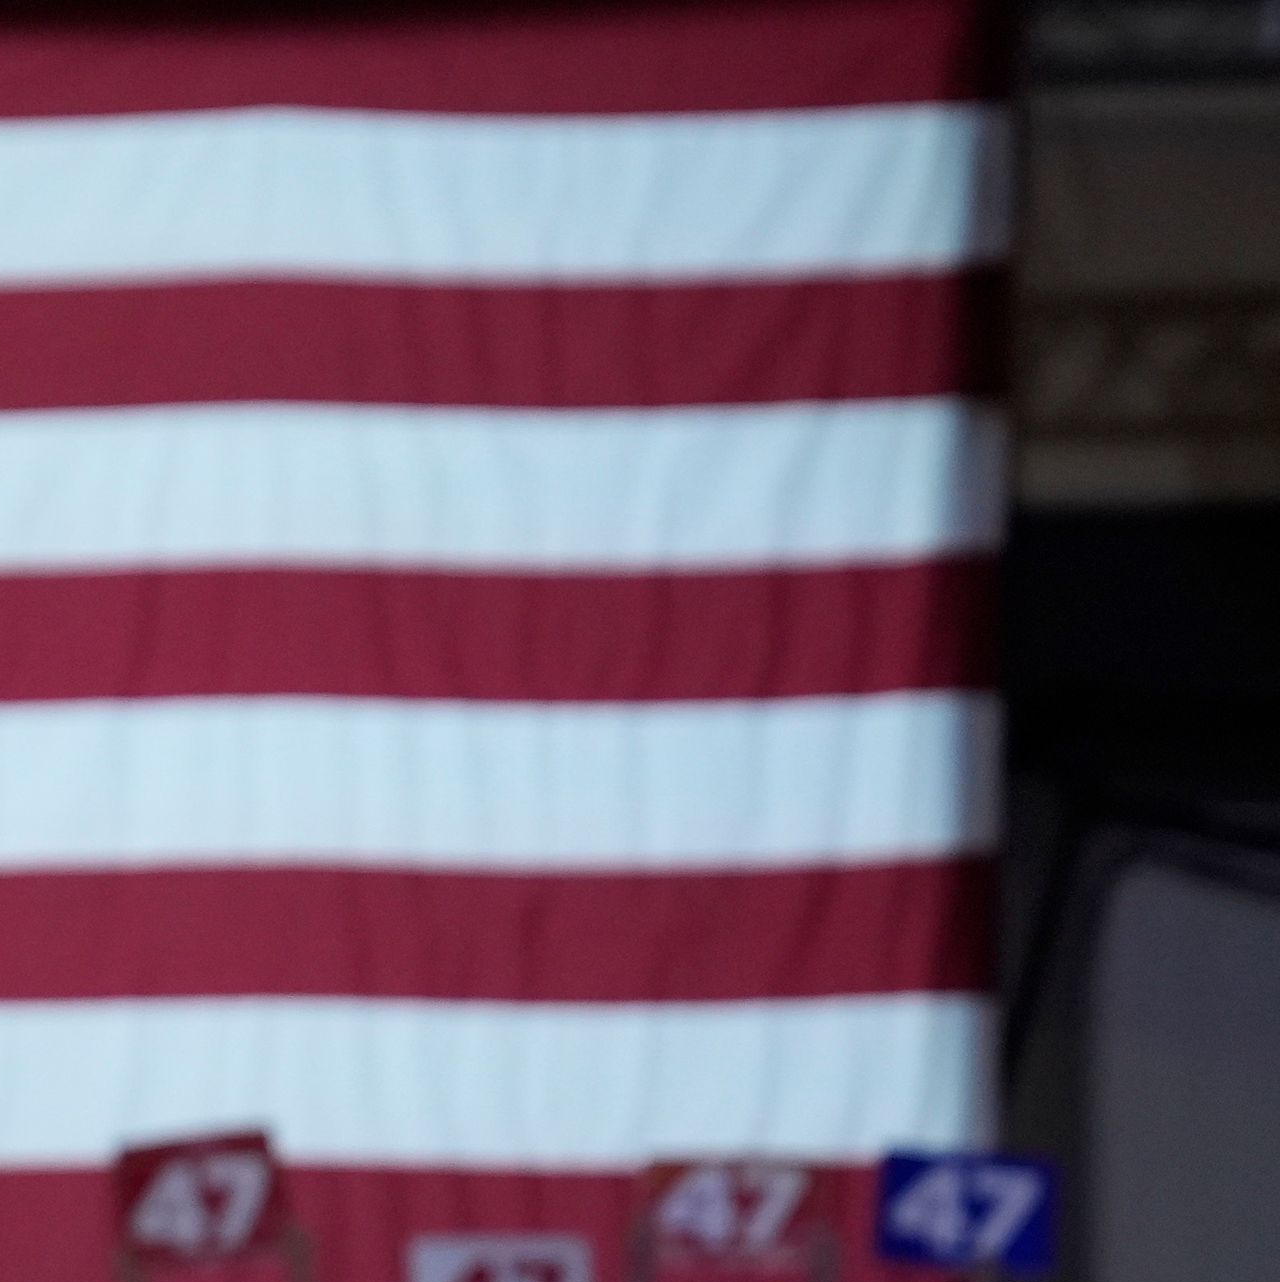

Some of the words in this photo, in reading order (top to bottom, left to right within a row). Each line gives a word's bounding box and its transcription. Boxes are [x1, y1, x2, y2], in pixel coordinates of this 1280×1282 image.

[129, 1150, 270, 1256] 47
[659, 1166, 806, 1248] 47
[889, 1164, 1044, 1261] 47
